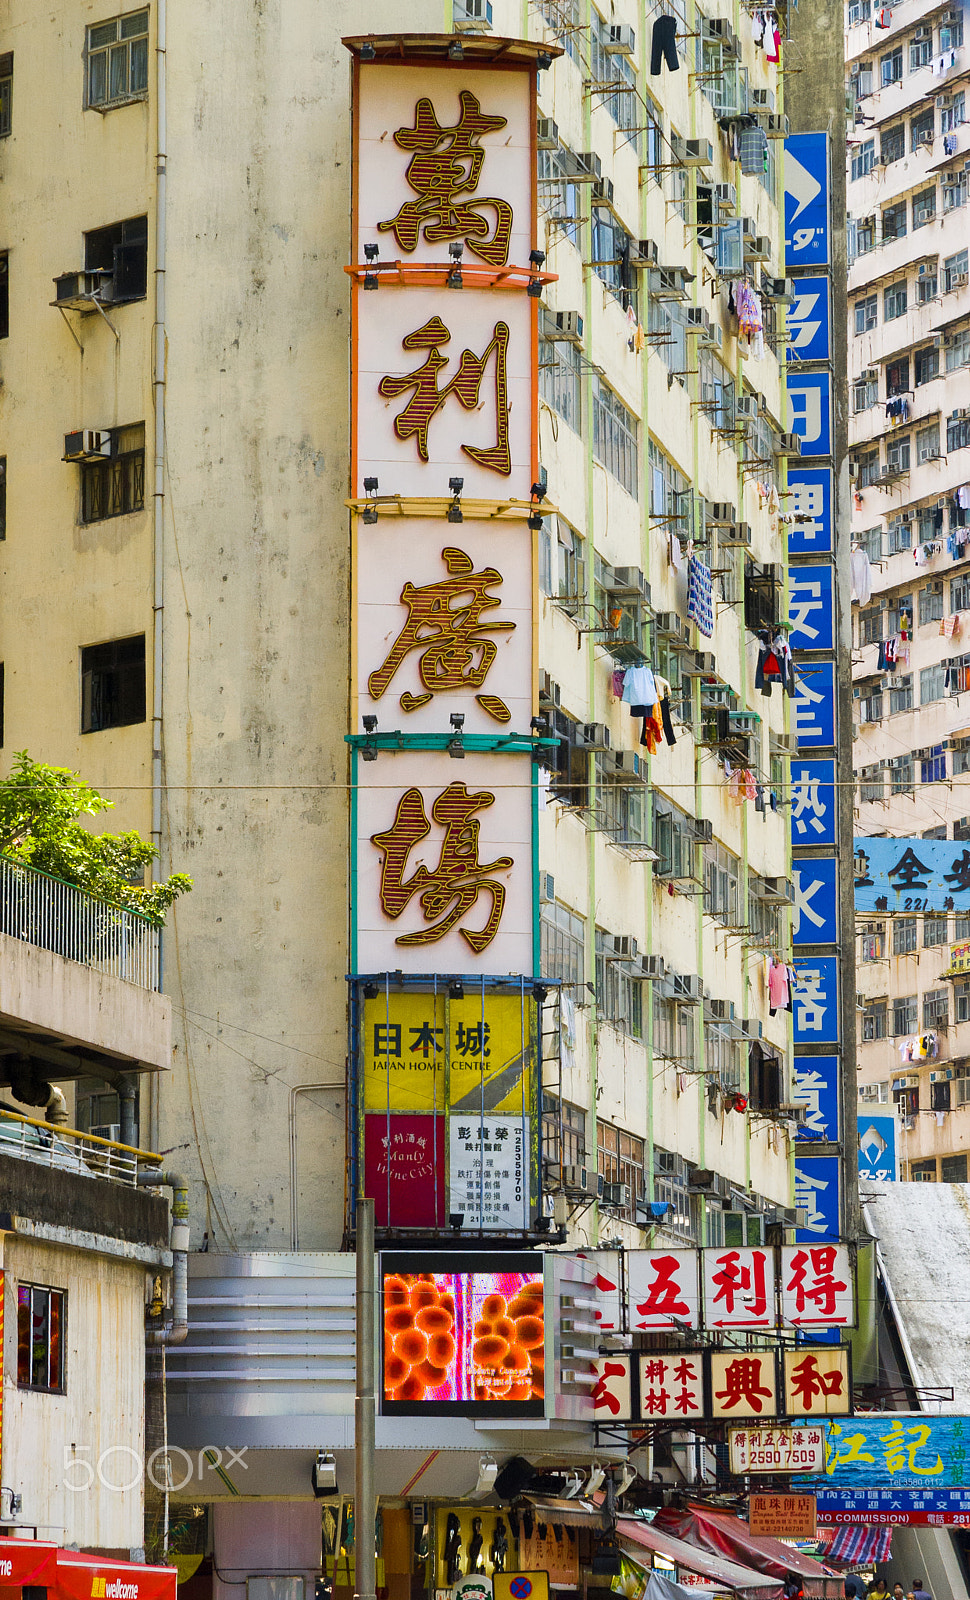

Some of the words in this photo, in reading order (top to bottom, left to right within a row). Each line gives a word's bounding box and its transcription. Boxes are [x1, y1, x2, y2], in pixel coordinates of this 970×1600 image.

[374, 1021, 491, 1058] 日本城
[373, 1061, 406, 1071] JAPAN
[409, 1062, 443, 1071] HOME
[451, 1061, 491, 1071] CENTRE
[383, 1150, 425, 1164] Manly
[409, 1162, 433, 1178] City
[750, 1451, 781, 1464] 2590
[785, 1449, 816, 1463] 7509
[106, 1578, 139, 1599] wellcome
